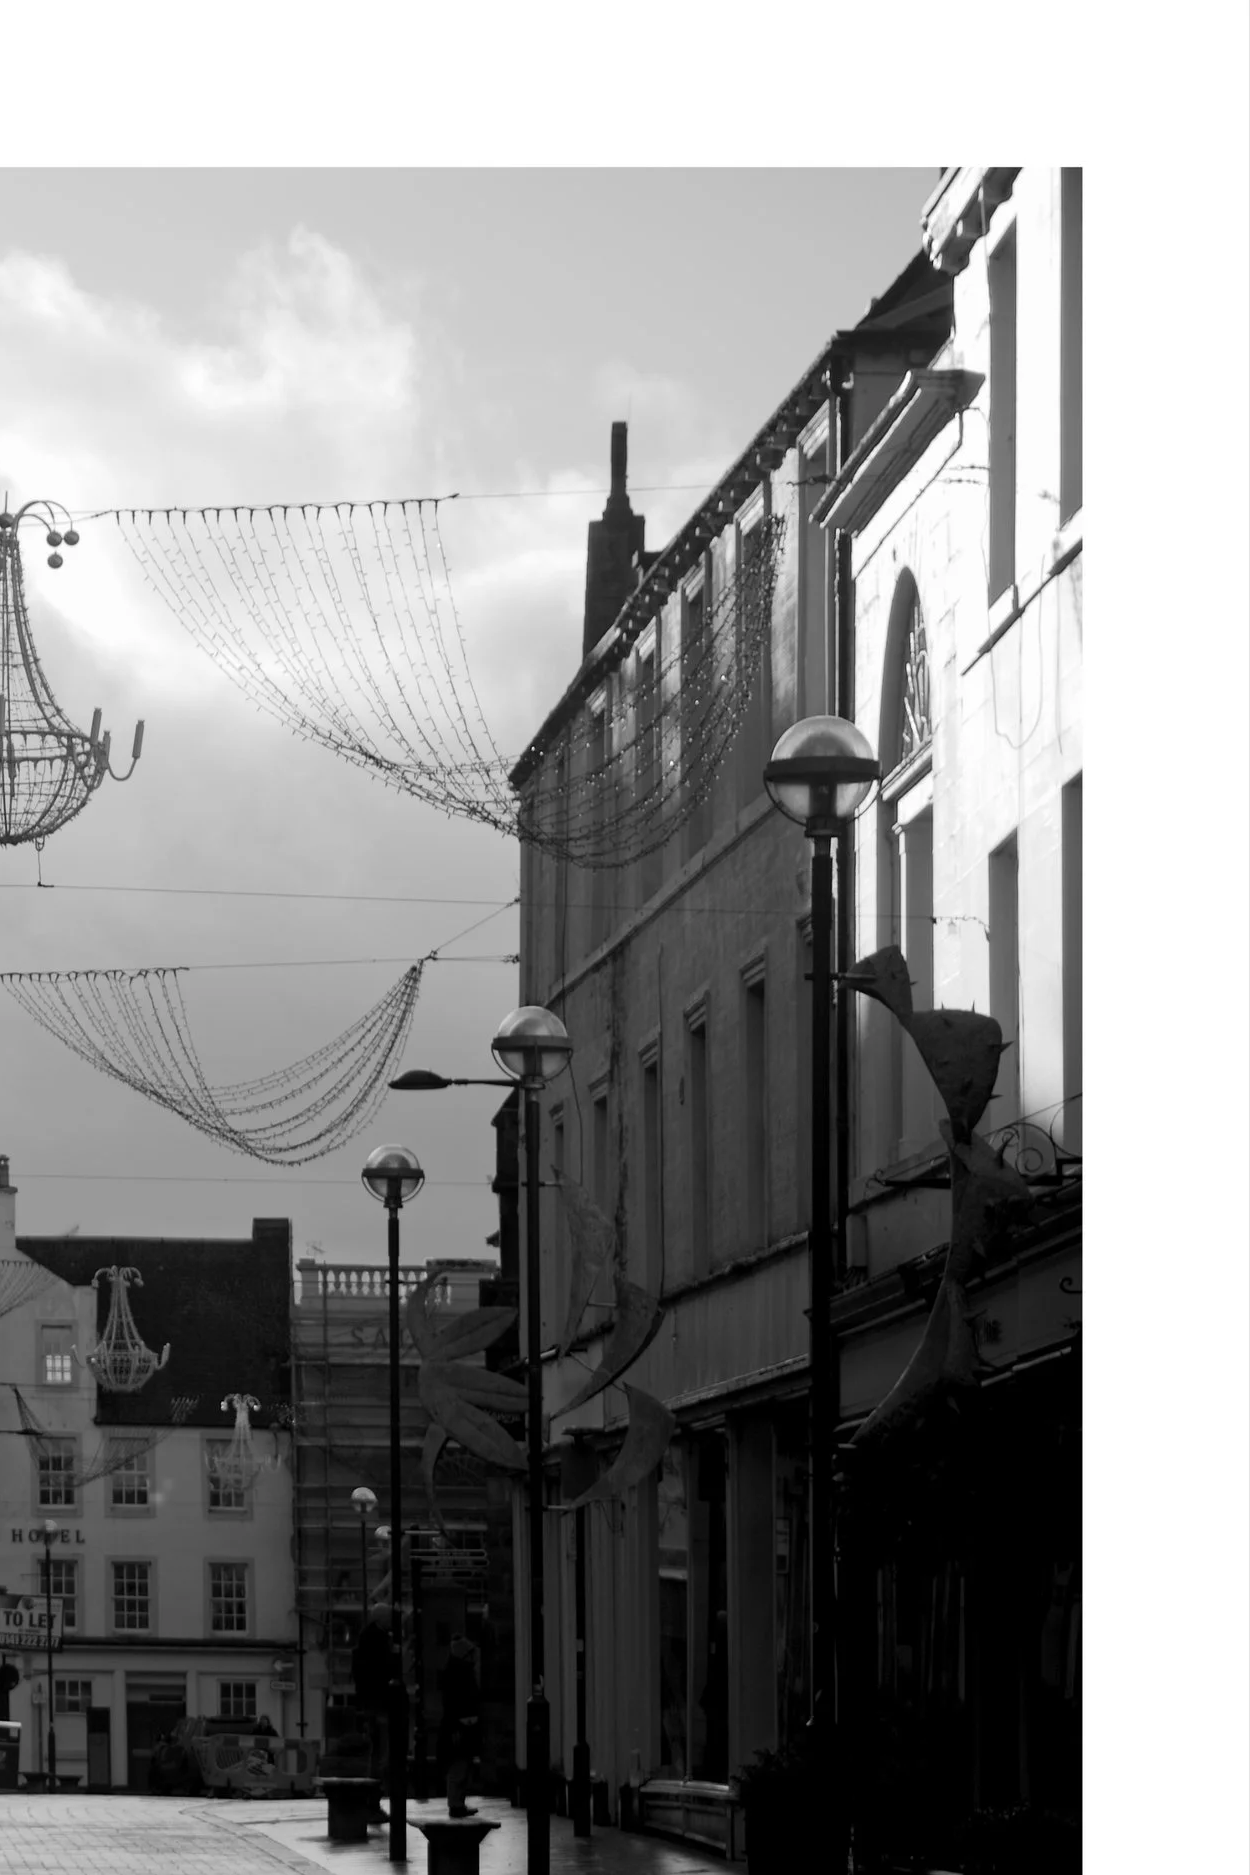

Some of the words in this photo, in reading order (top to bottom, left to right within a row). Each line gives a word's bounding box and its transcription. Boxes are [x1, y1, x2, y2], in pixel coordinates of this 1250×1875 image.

[12, 1528, 86, 1544] HOEL
[4, 1610, 23, 1627] TO
[28, 1612, 57, 1630] LET
